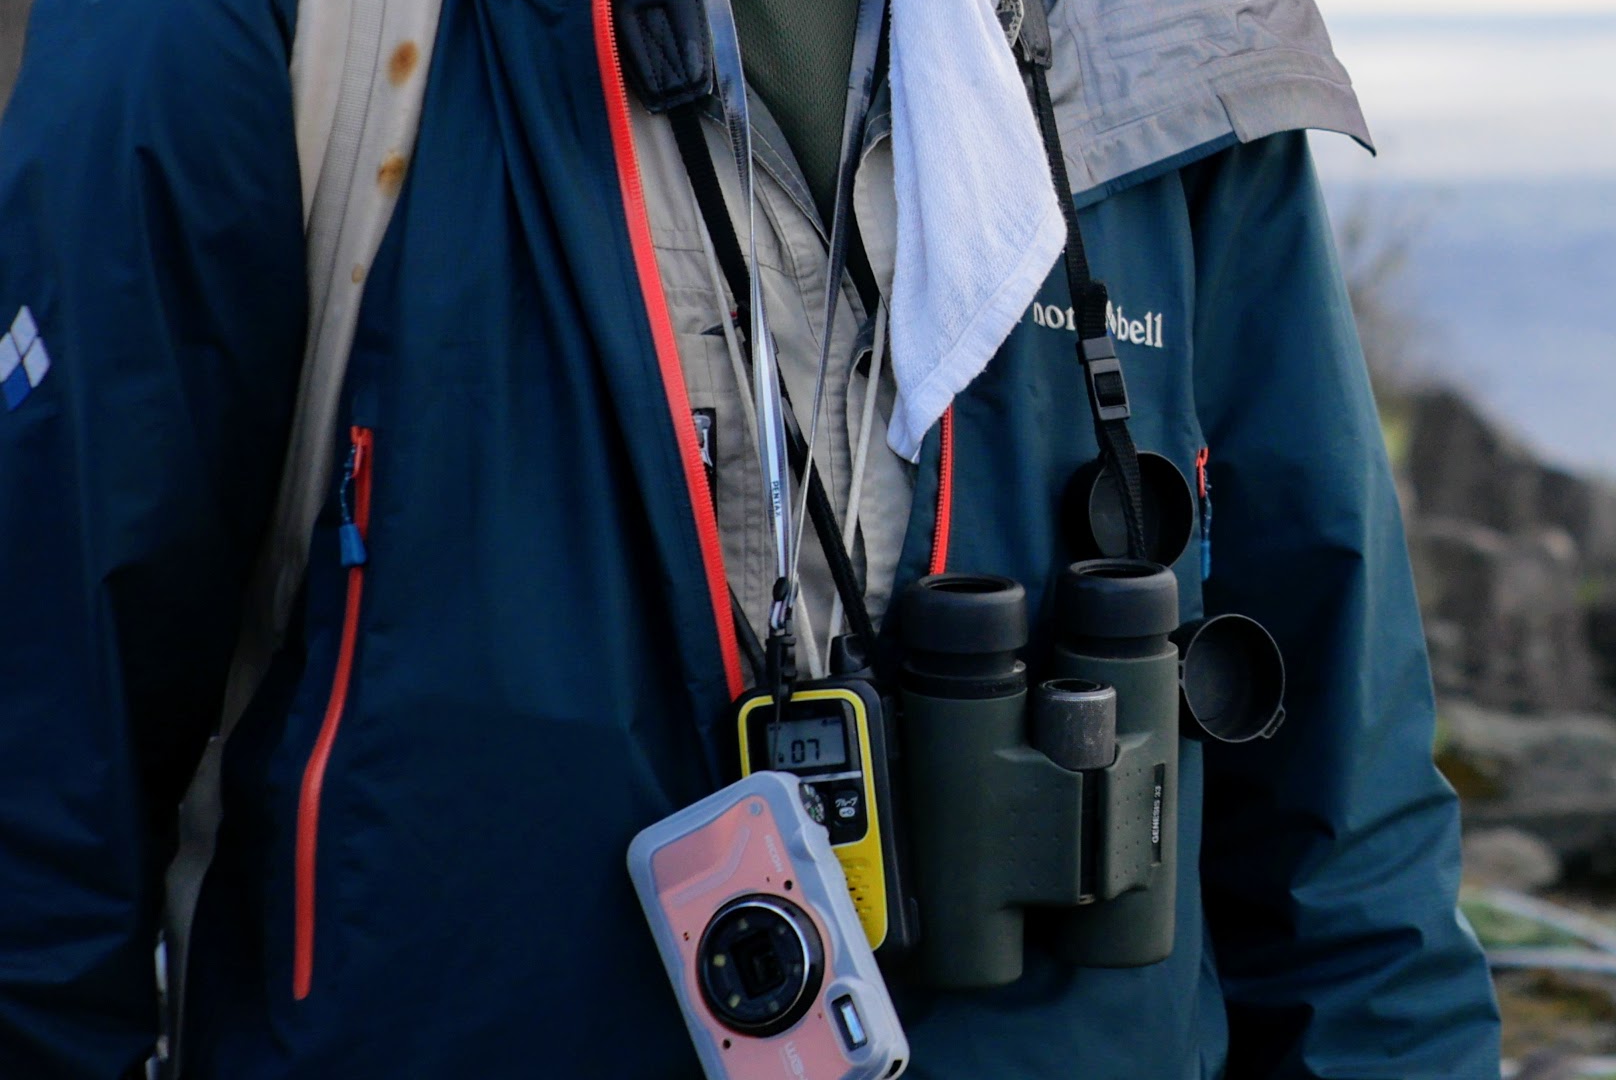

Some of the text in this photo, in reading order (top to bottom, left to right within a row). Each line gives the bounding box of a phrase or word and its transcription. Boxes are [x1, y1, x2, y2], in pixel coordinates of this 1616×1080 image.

[772, 480, 782, 517] PENTAX
[791, 738, 820, 764] 07
[1151, 799, 1161, 844] GENESIS
